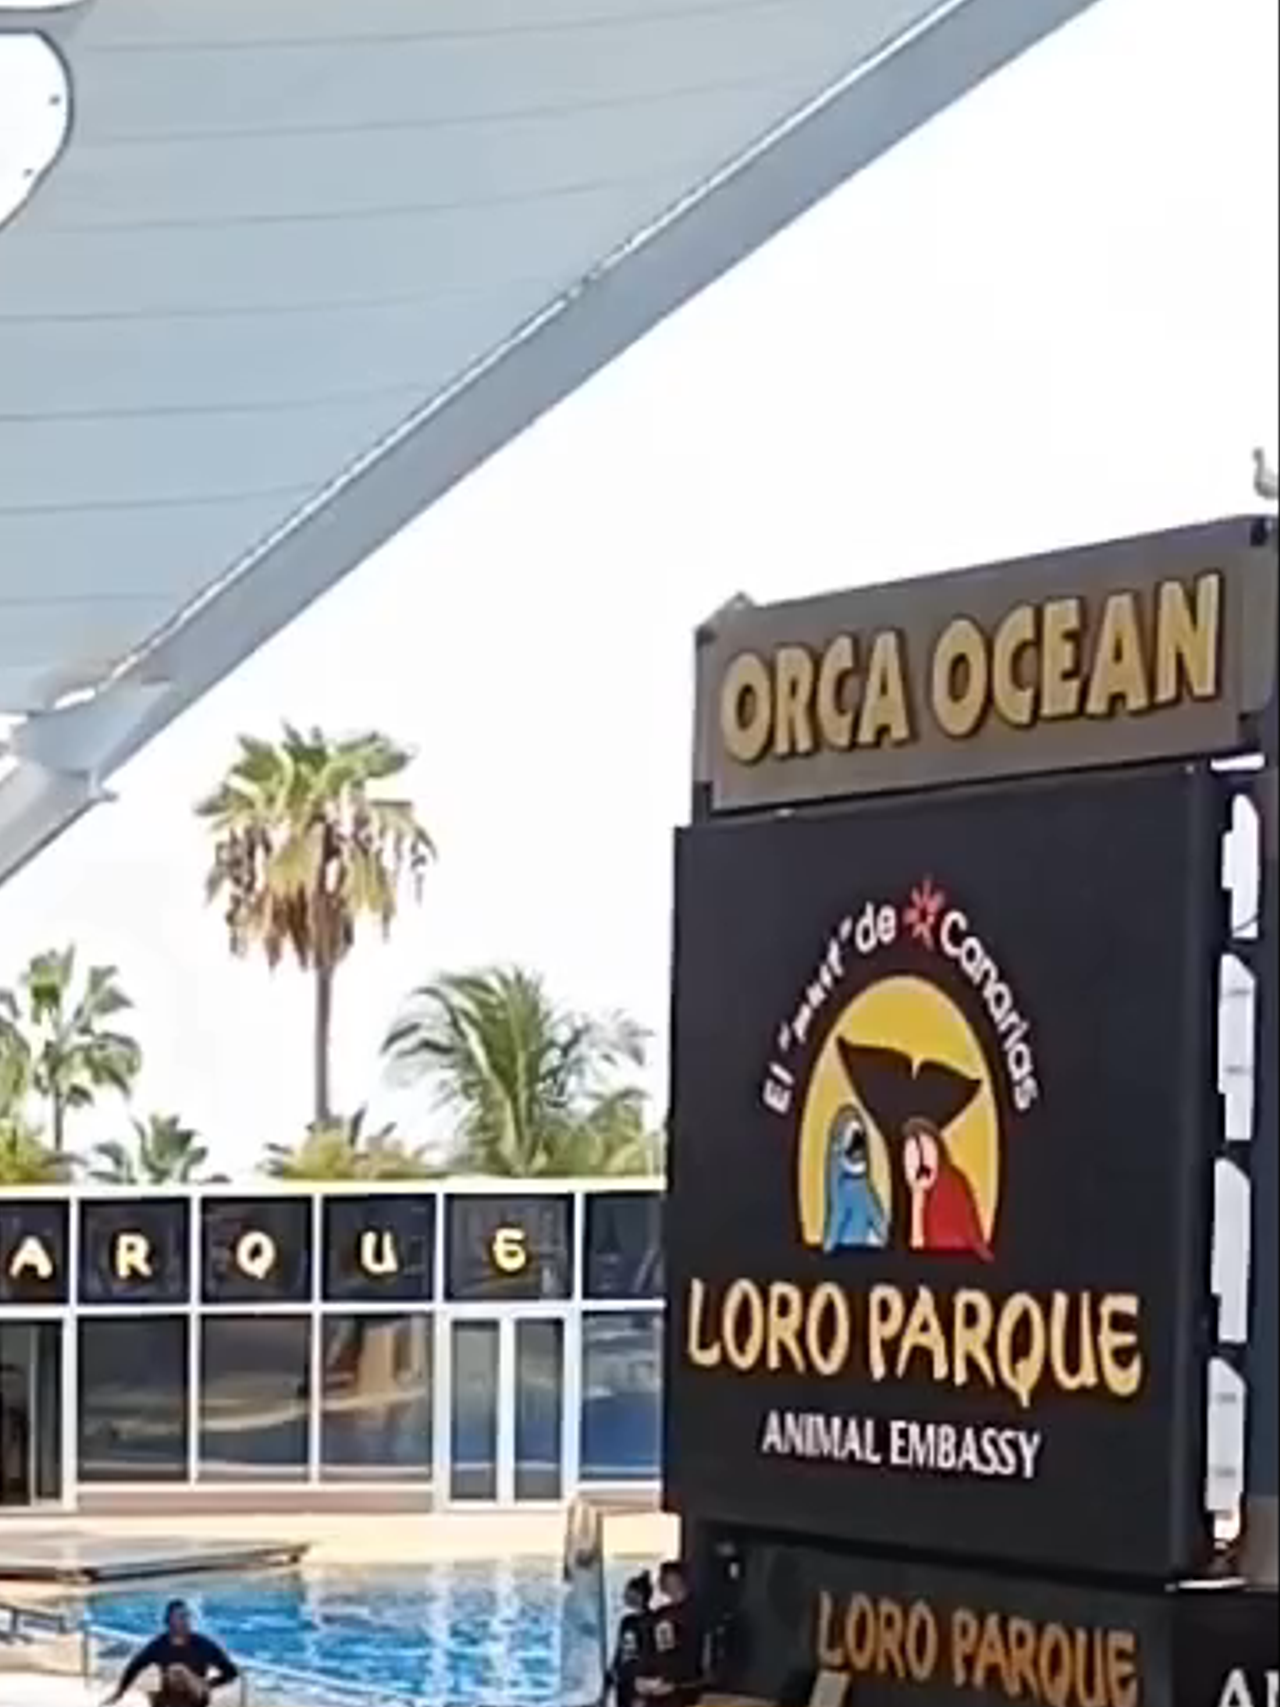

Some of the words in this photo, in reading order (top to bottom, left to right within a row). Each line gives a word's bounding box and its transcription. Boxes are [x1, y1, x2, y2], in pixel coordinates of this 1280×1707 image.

[719, 629, 912, 762] ORCA
[931, 573, 1222, 738] OCEAN
[762, 1061, 795, 1114] El
[855, 900, 897, 953] de
[940, 910, 1039, 1112] Canarias
[687, 1277, 851, 1376] LORO
[867, 1284, 1141, 1408] PARQUE
[760, 1408, 882, 1465] ANIMAL
[889, 1419, 1042, 1480] EMBASSY
[817, 1590, 939, 1682] LORO
